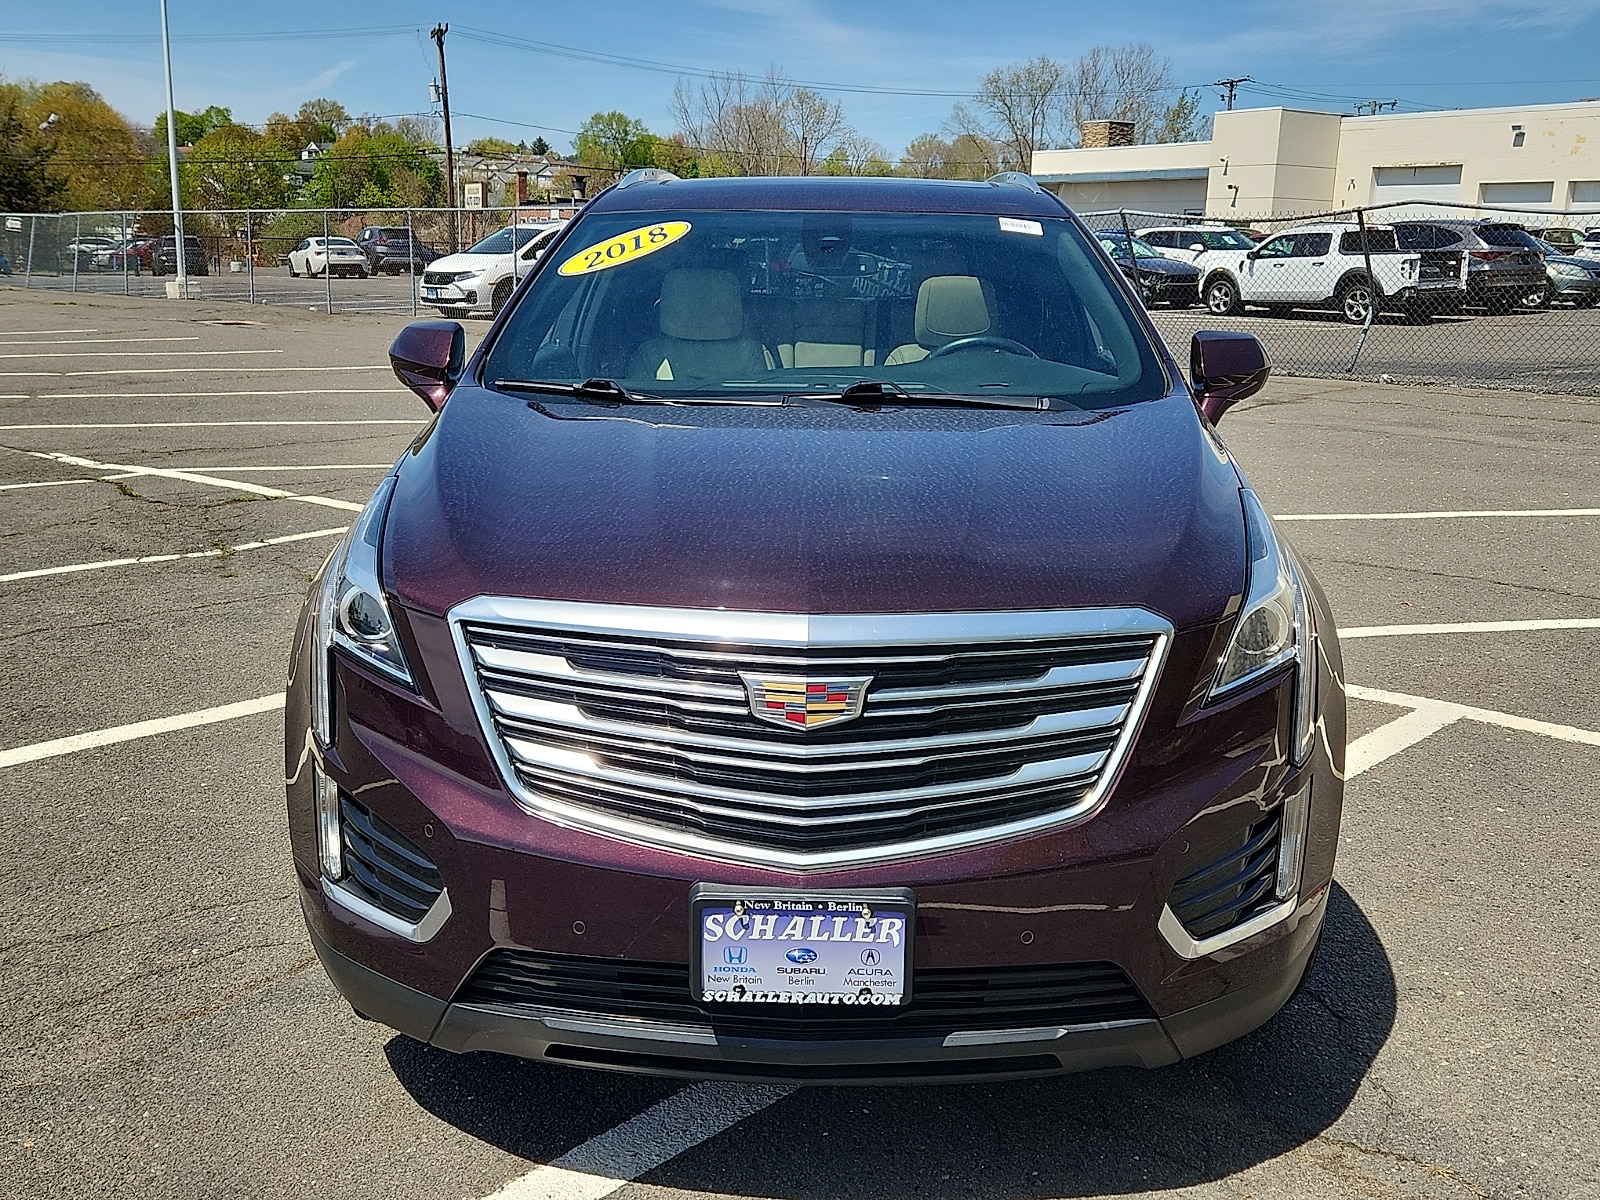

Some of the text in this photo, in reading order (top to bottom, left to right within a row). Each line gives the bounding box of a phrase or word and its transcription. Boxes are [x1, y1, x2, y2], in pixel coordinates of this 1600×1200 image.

[584, 226, 668, 269] 2018
[743, 900, 863, 912] New Britain Berlin
[703, 914, 903, 948] SCHALLER
[776, 967, 826, 975] SUBARU
[847, 968, 893, 976] ACURA
[707, 974, 762, 985] New Britain
[788, 976, 815, 986] Berlin
[842, 977, 897, 987] Manchester
[702, 990, 903, 1006] SCHALLERAUTO.COM
